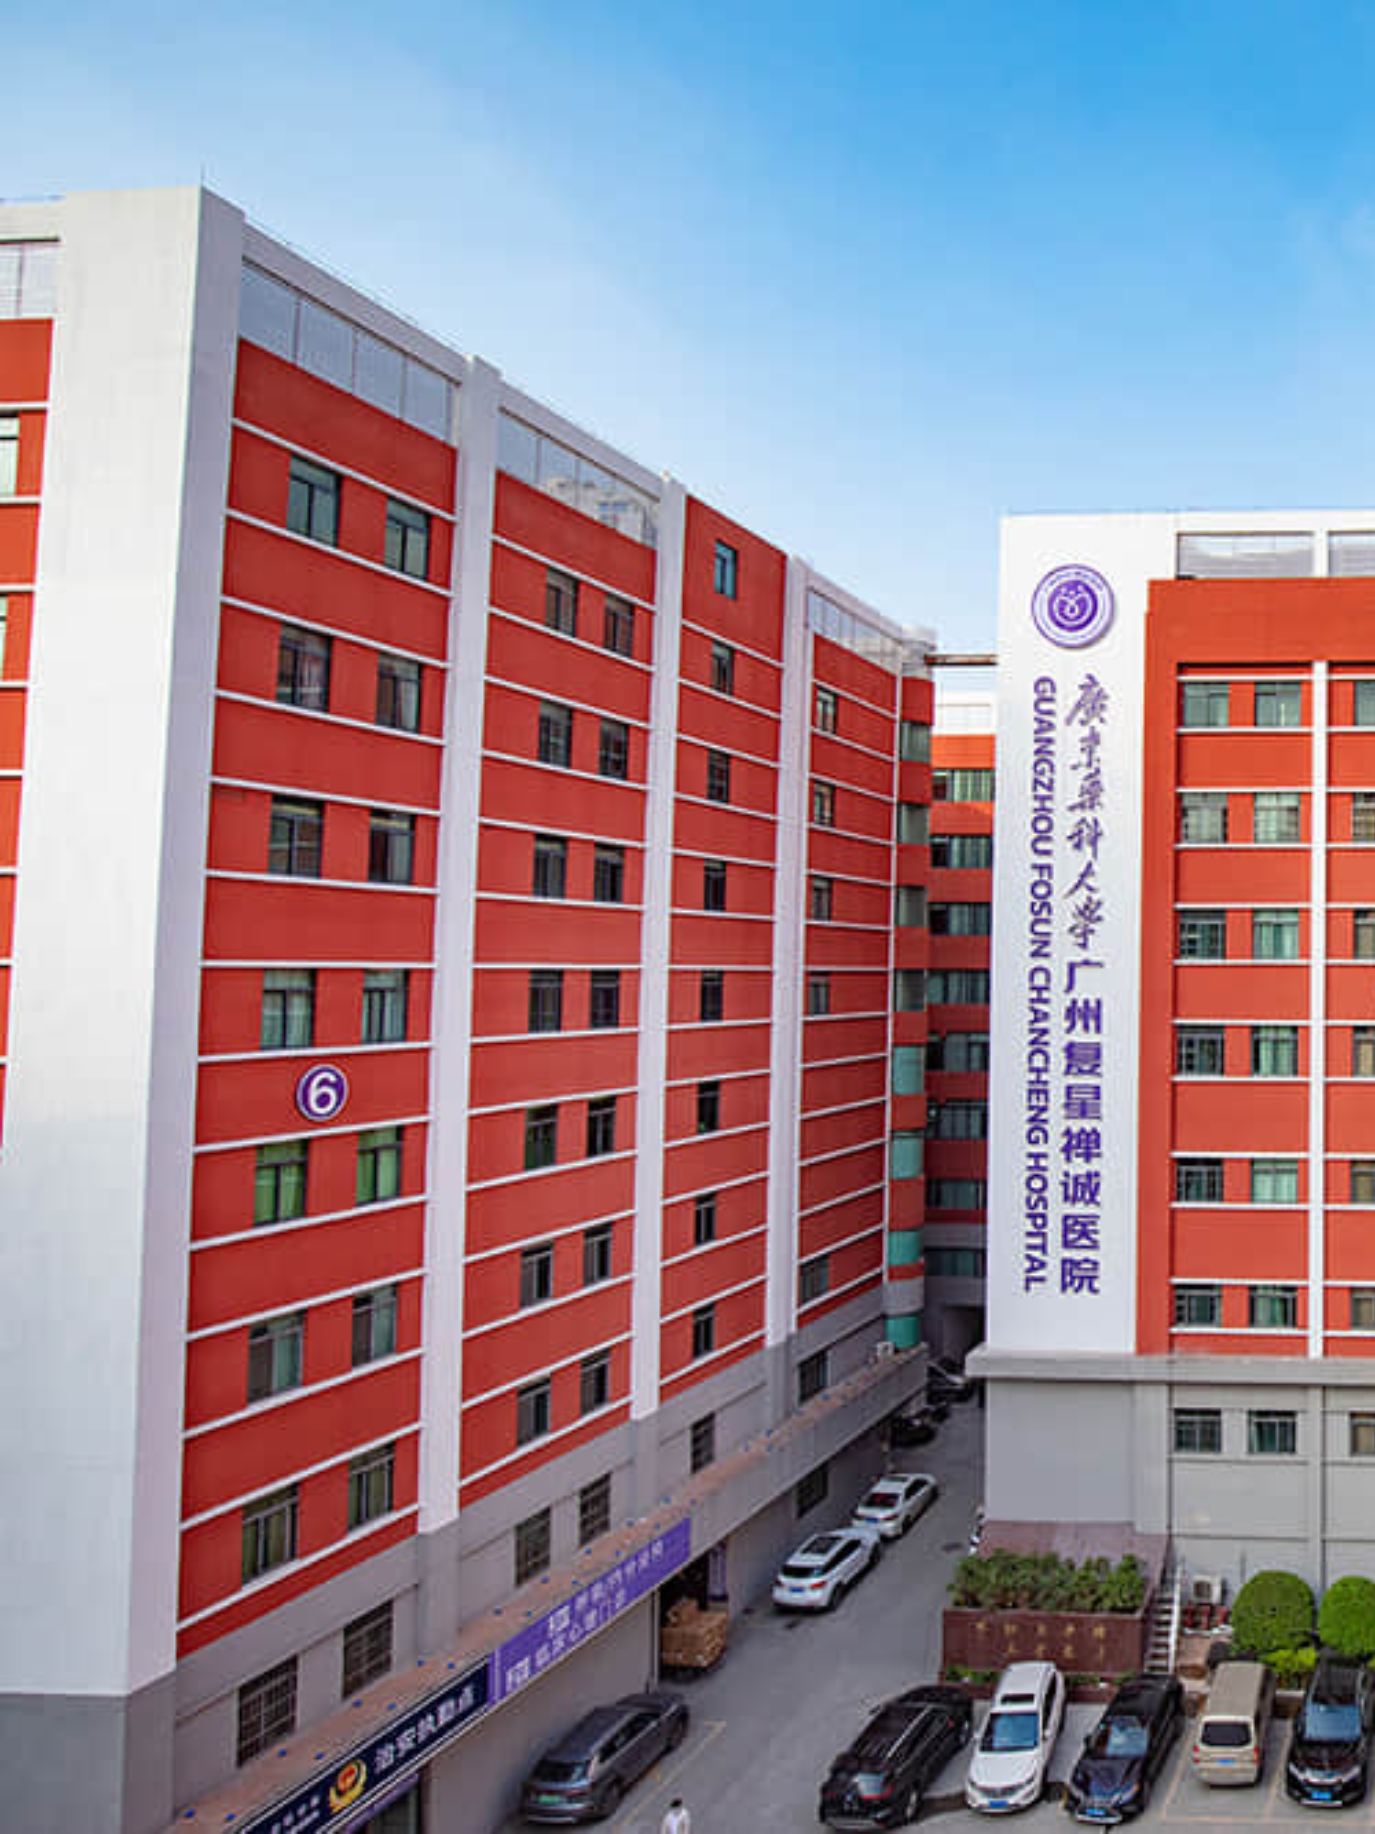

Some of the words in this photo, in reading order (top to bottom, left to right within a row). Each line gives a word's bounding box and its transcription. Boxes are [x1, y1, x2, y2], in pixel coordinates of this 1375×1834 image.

[1031, 676, 1057, 856] GUANGZHOU
[1029, 862, 1054, 959] FOSUN
[309, 1071, 336, 1114] 6
[1025, 964, 1052, 1145] CHANCHENG
[1022, 1151, 1050, 1292] HOSPITAL
